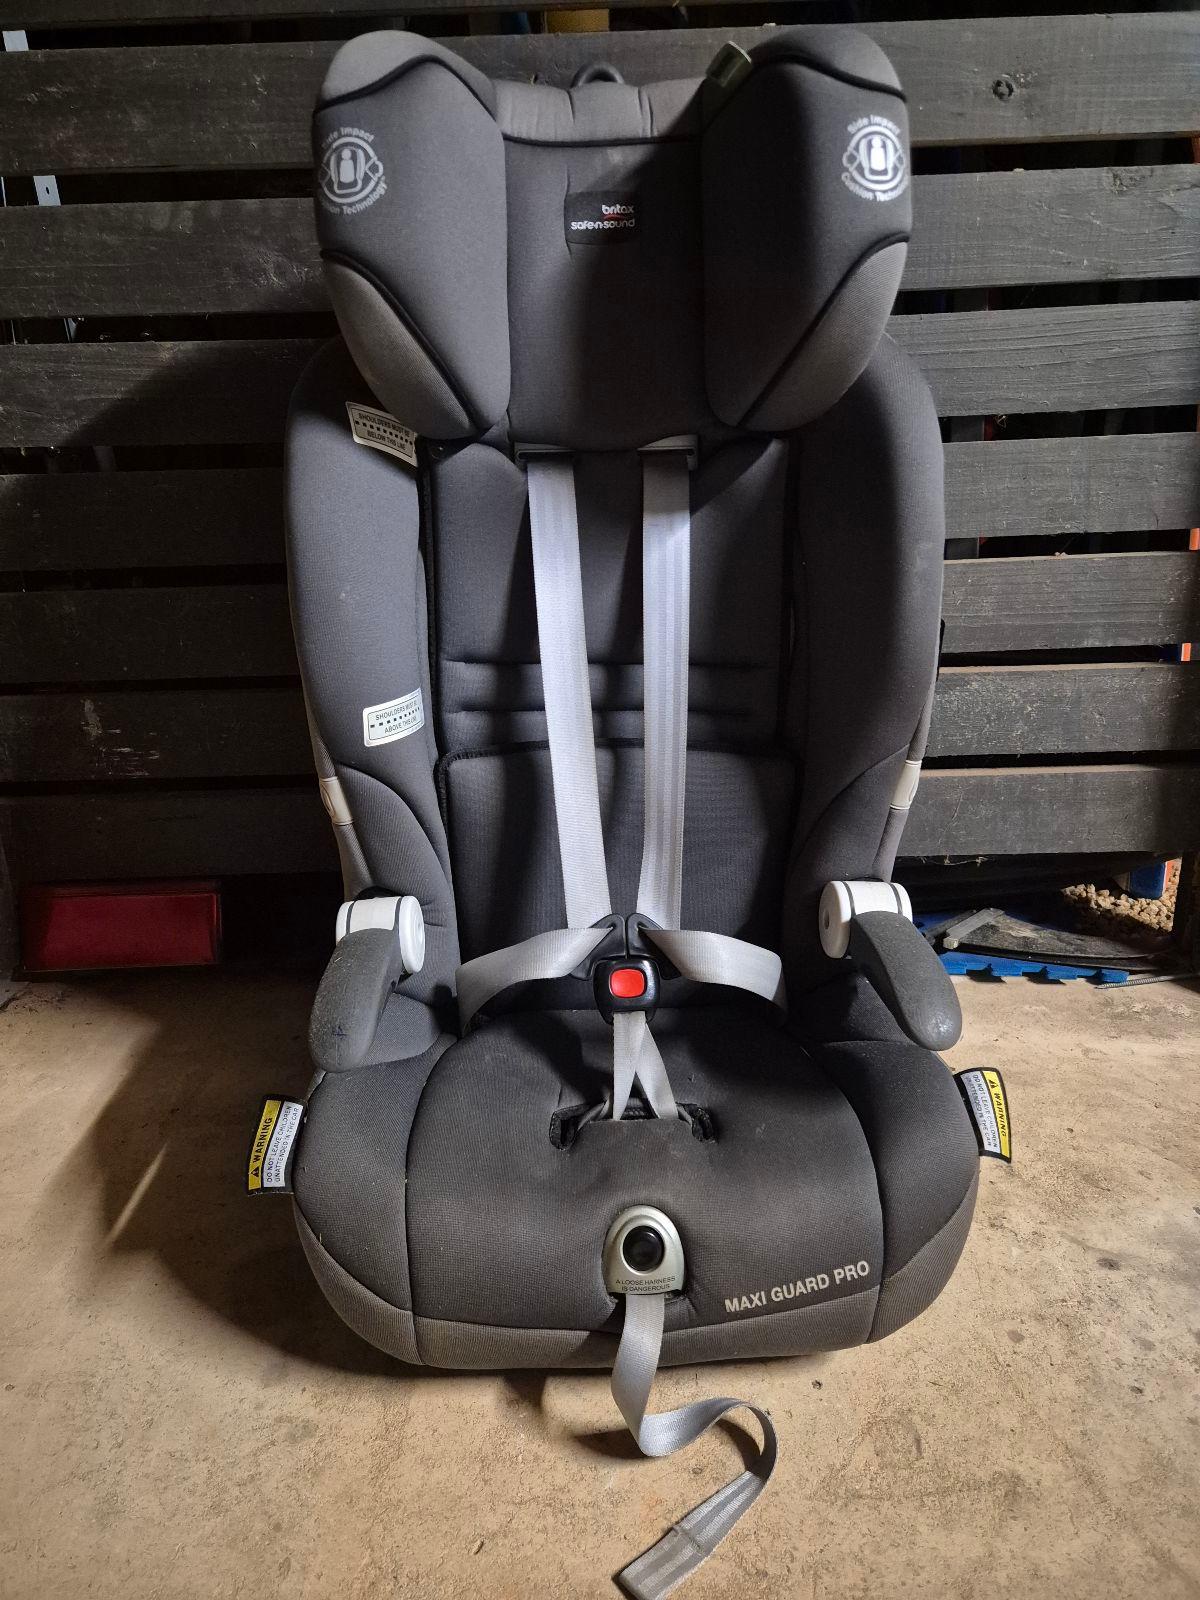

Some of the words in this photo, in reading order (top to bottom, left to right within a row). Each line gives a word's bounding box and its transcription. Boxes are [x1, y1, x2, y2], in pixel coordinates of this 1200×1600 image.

[340, 127, 375, 143] Impact
[375, 705, 405, 720] SHOULDERS
[384, 722, 402, 734] ABOVE
[973, 1074, 980, 1083] DO
[981, 1096, 990, 1115] LEAVE
[994, 1092, 1006, 1137] WARNING
[286, 1120, 296, 1134] THE
[253, 1117, 273, 1164] WARNING
[266, 1171, 273, 1183] DO
[271, 1137, 282, 1156] LEAVE
[278, 1105, 292, 1136] CHILDREN
[284, 1134, 292, 1142] IN
[274, 1141, 289, 1182] UNATTENDED
[629, 1283, 671, 1292] DANGEROUS
[645, 1276, 676, 1286] HARNESS
[724, 1291, 767, 1313] MAXI
[771, 1273, 830, 1302] GUARD
[833, 1260, 870, 1285] PRO
